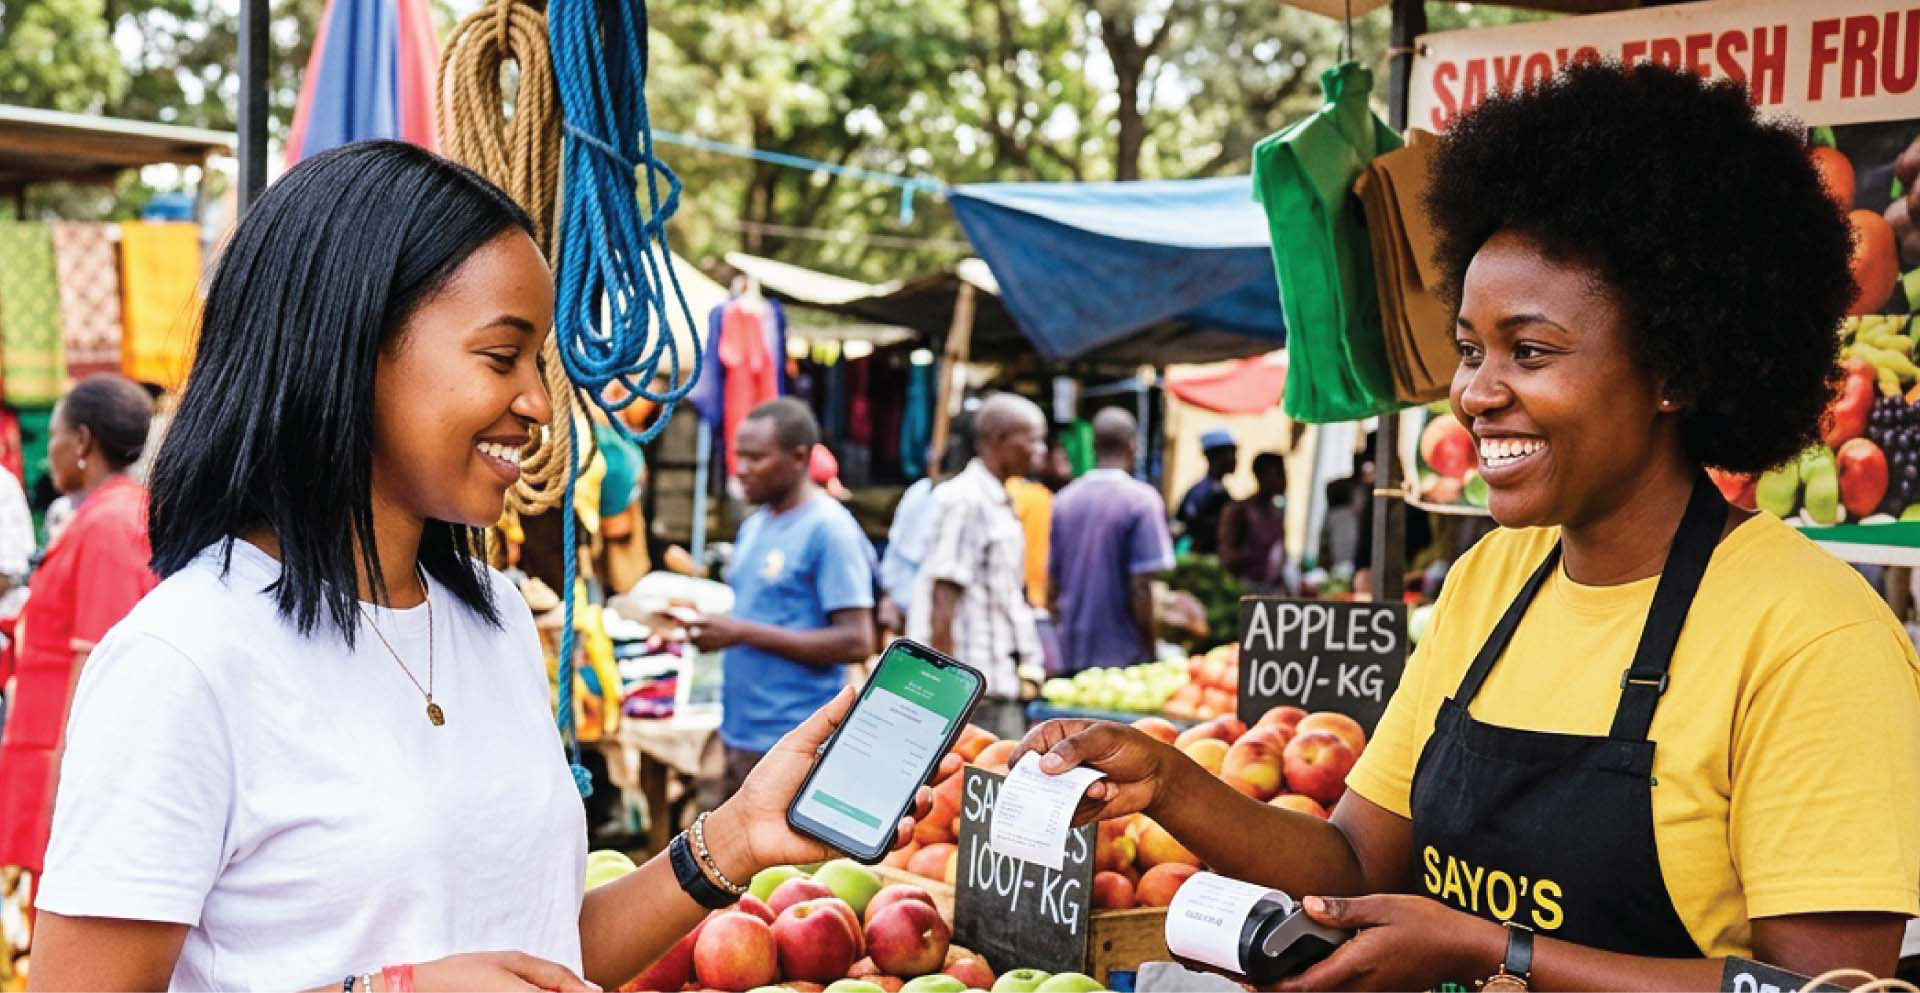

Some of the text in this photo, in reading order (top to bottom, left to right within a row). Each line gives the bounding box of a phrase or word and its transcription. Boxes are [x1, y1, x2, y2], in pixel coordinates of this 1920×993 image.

[1807, 9, 1920, 102] FRU
[1244, 602, 1396, 653] APPLES
[1423, 845, 1564, 930] SAYO'S
